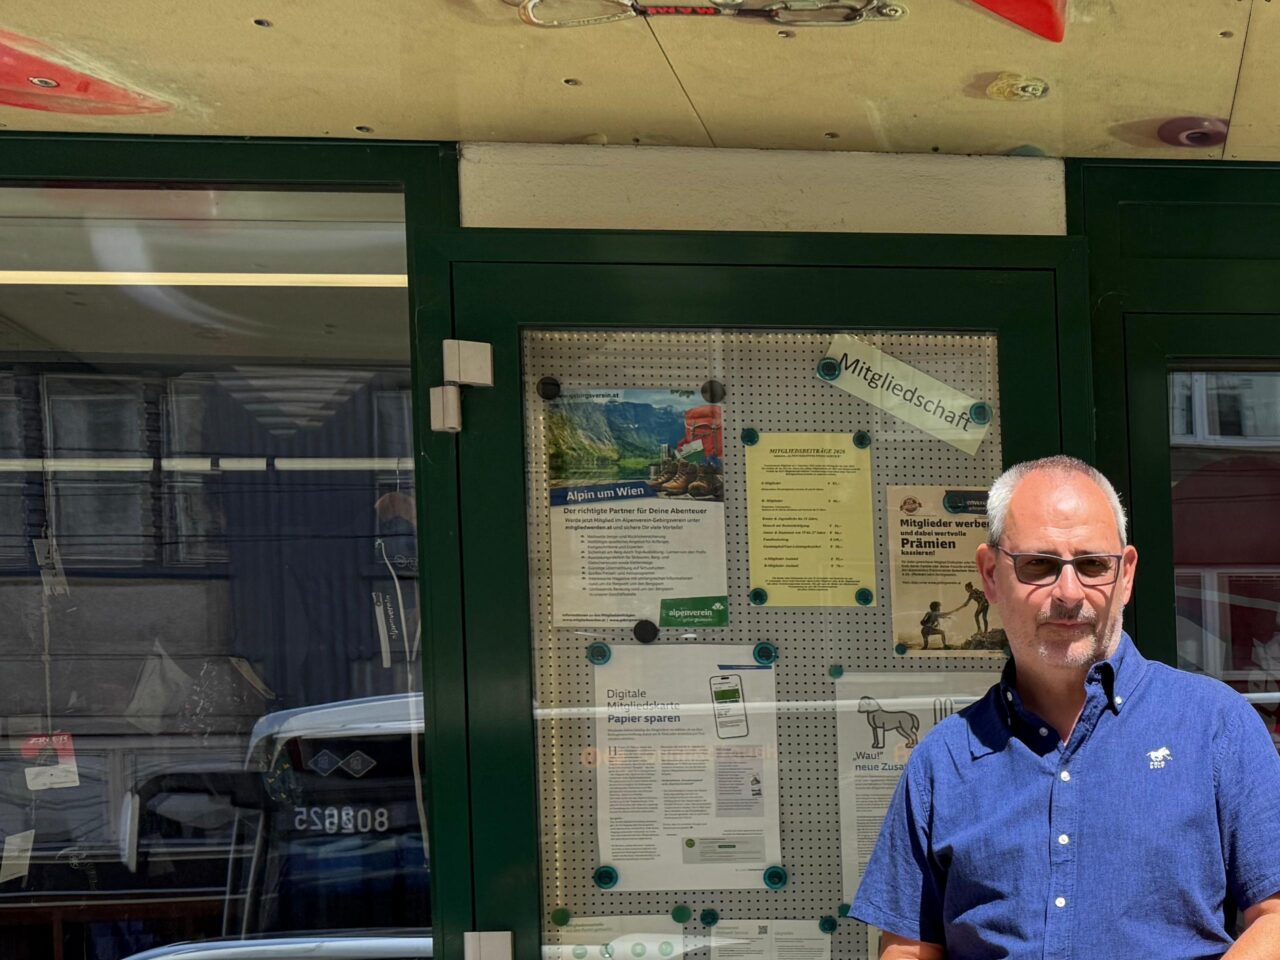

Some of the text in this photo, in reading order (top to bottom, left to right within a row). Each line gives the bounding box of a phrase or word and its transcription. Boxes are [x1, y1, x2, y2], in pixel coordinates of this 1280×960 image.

[839, 351, 973, 433] Mitgliedschaft
[566, 486, 644, 502] Alpin um Wien
[563, 507, 576, 515] Der
[578, 507, 608, 516] richtigte
[609, 507, 635, 515] Partner
[649, 507, 668, 515] Deine
[671, 507, 707, 515] Abenteuer
[900, 519, 952, 529] Mitglieder
[901, 537, 956, 549] Prämien
[669, 608, 712, 617] alpenverein
[607, 689, 646, 701] Digitale
[607, 701, 680, 713] Mitgliedskarte
[608, 714, 681, 725] Papier sparen
[855, 763, 879, 771] neue
